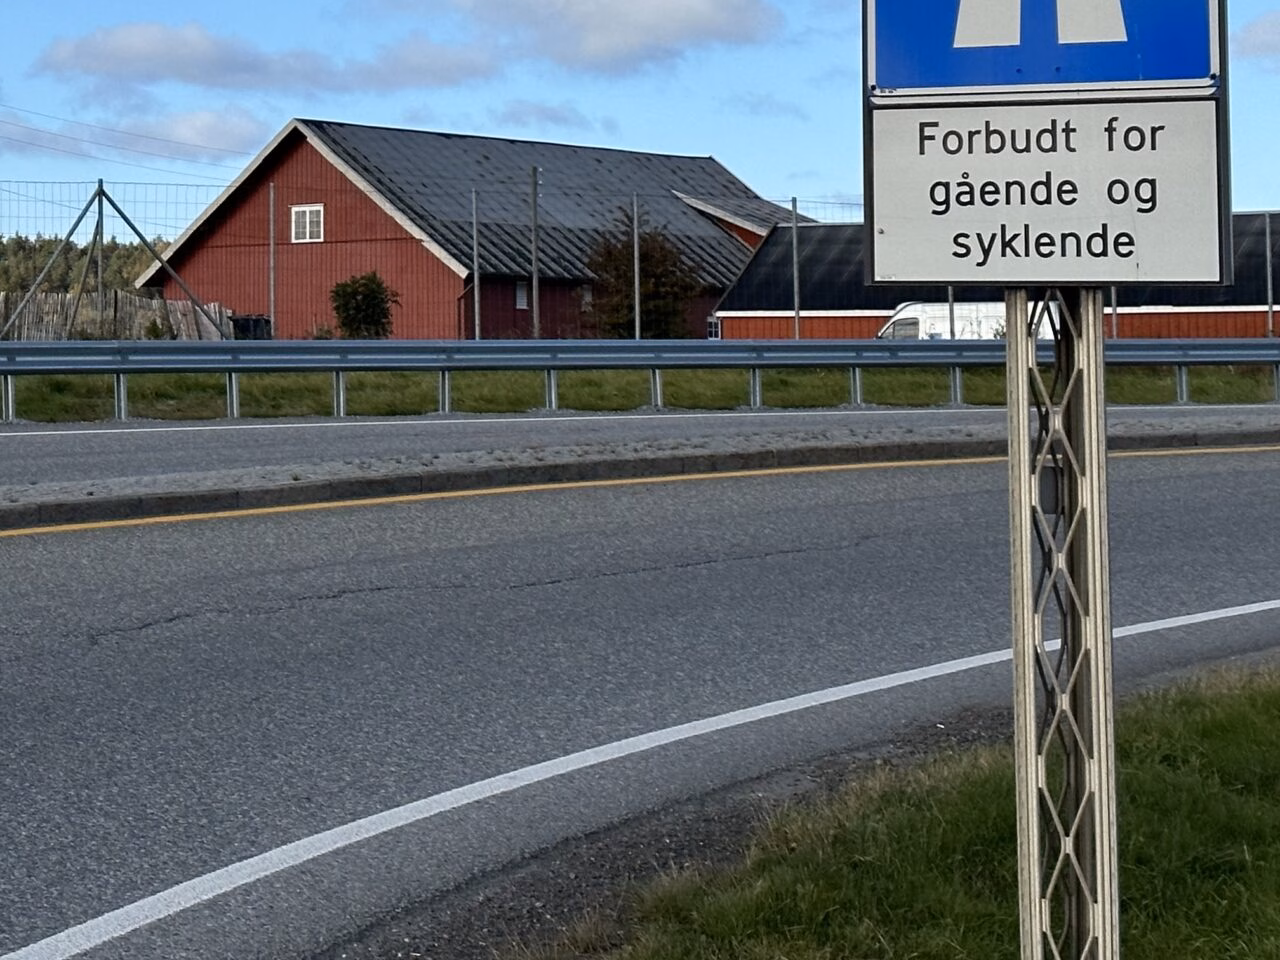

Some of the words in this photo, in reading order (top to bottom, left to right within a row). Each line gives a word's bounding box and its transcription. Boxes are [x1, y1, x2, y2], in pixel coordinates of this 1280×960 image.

[918, 118, 1078, 156] Forbudt
[1103, 116, 1166, 152] for
[929, 171, 1079, 216] gående
[1107, 178, 1158, 214] og
[951, 222, 1136, 268] syklende
